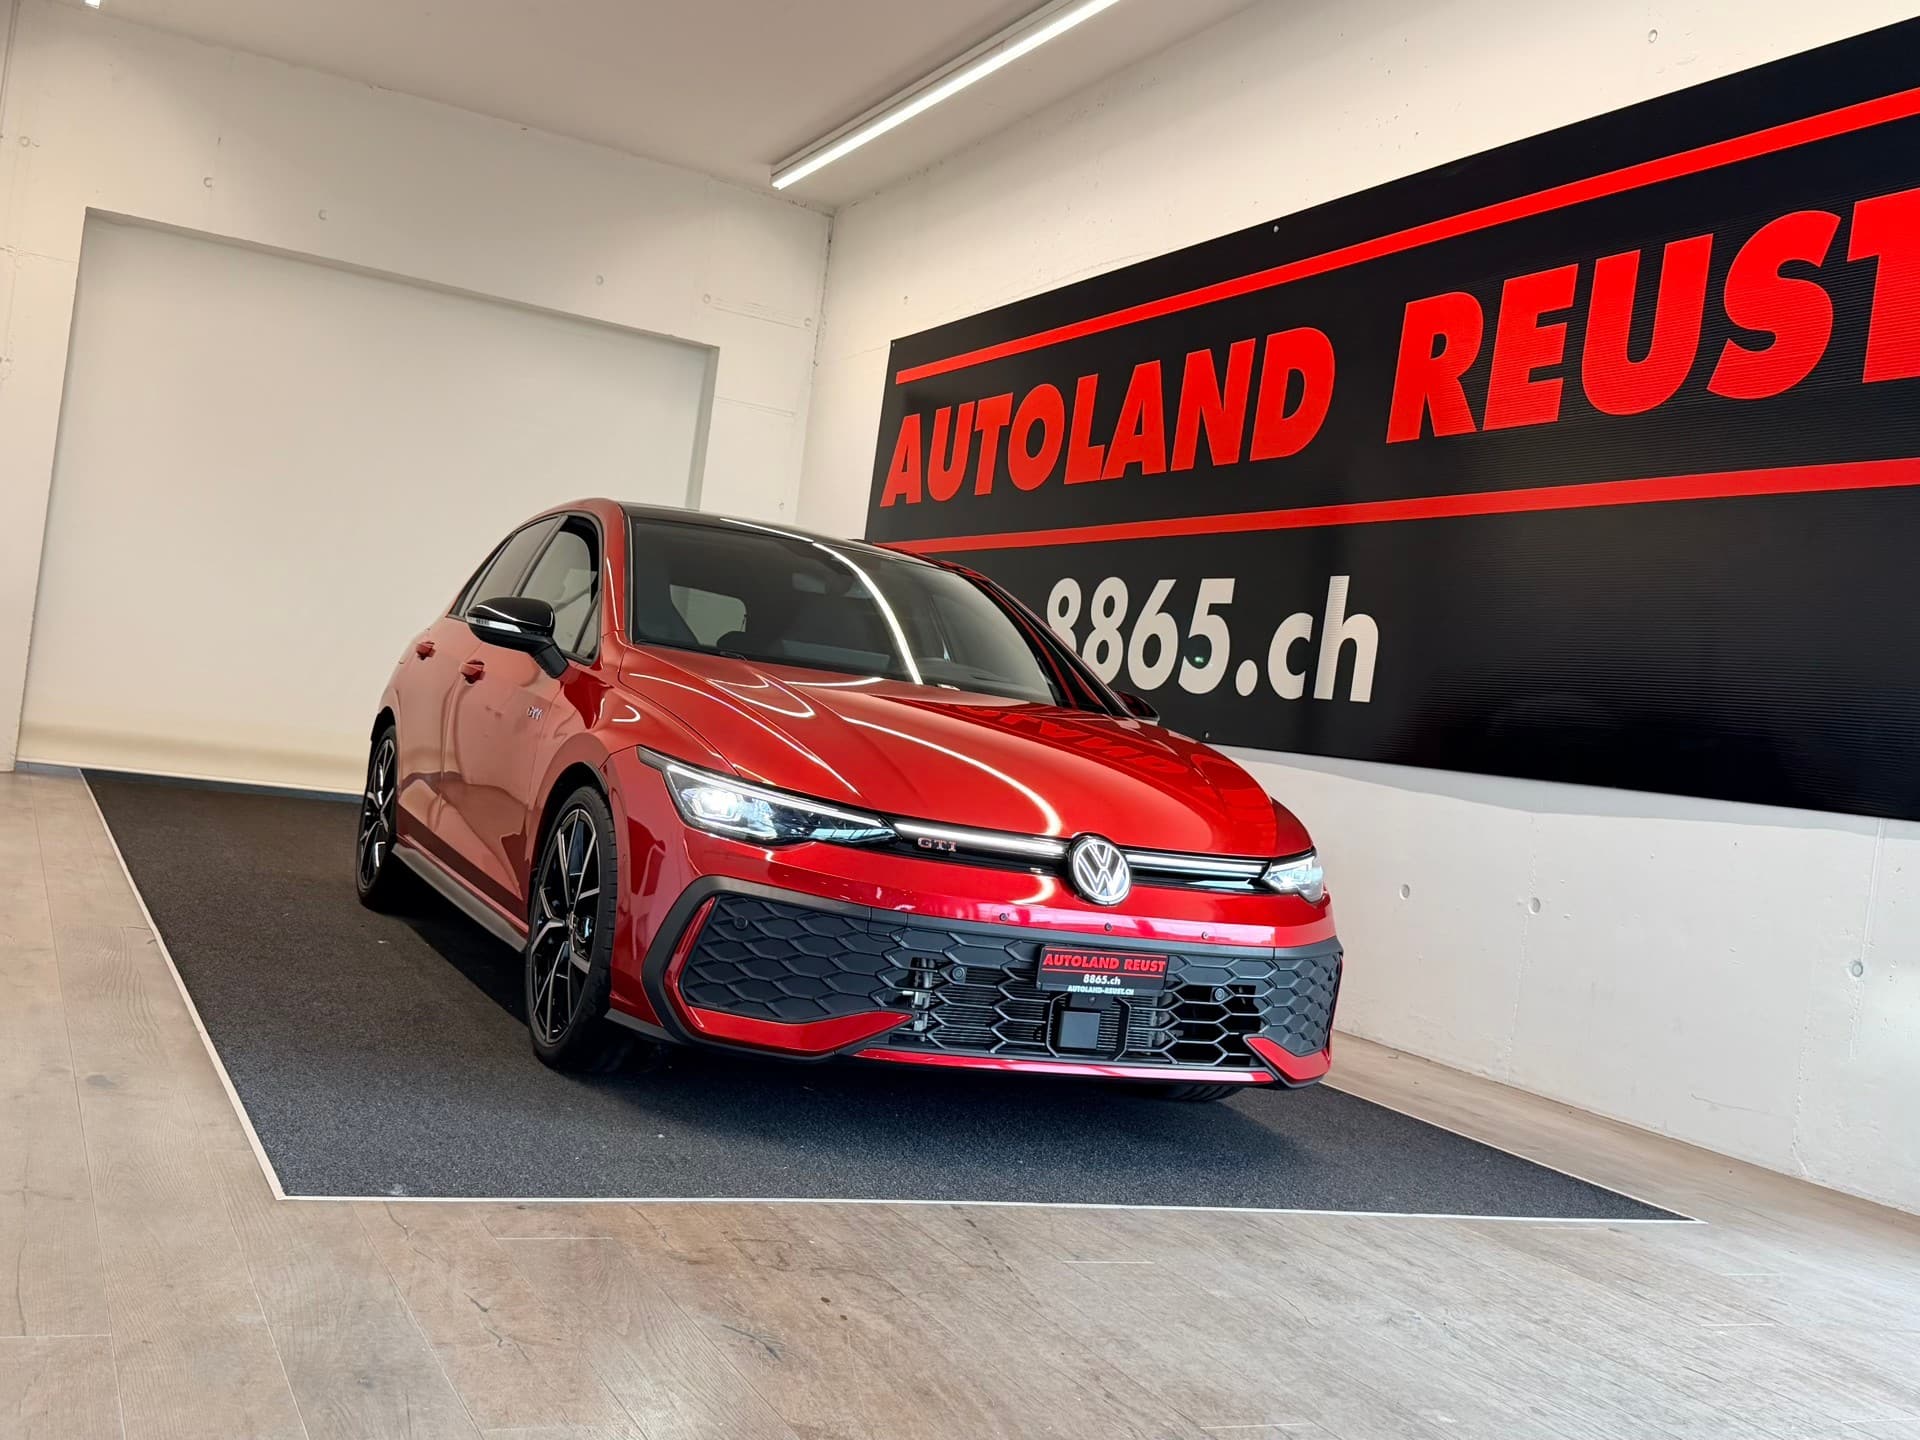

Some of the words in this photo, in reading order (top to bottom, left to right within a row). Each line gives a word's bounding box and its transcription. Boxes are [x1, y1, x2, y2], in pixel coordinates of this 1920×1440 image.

[879, 326, 1336, 508] AUTOLAND
[1386, 187, 1920, 444] REUST
[1046, 575, 1379, 704] 8865.ch
[917, 837, 957, 853] GTI
[1043, 953, 1120, 970] AUTOLAND
[1124, 958, 1166, 973] REUST
[1083, 973, 1121, 986] 8865.ch
